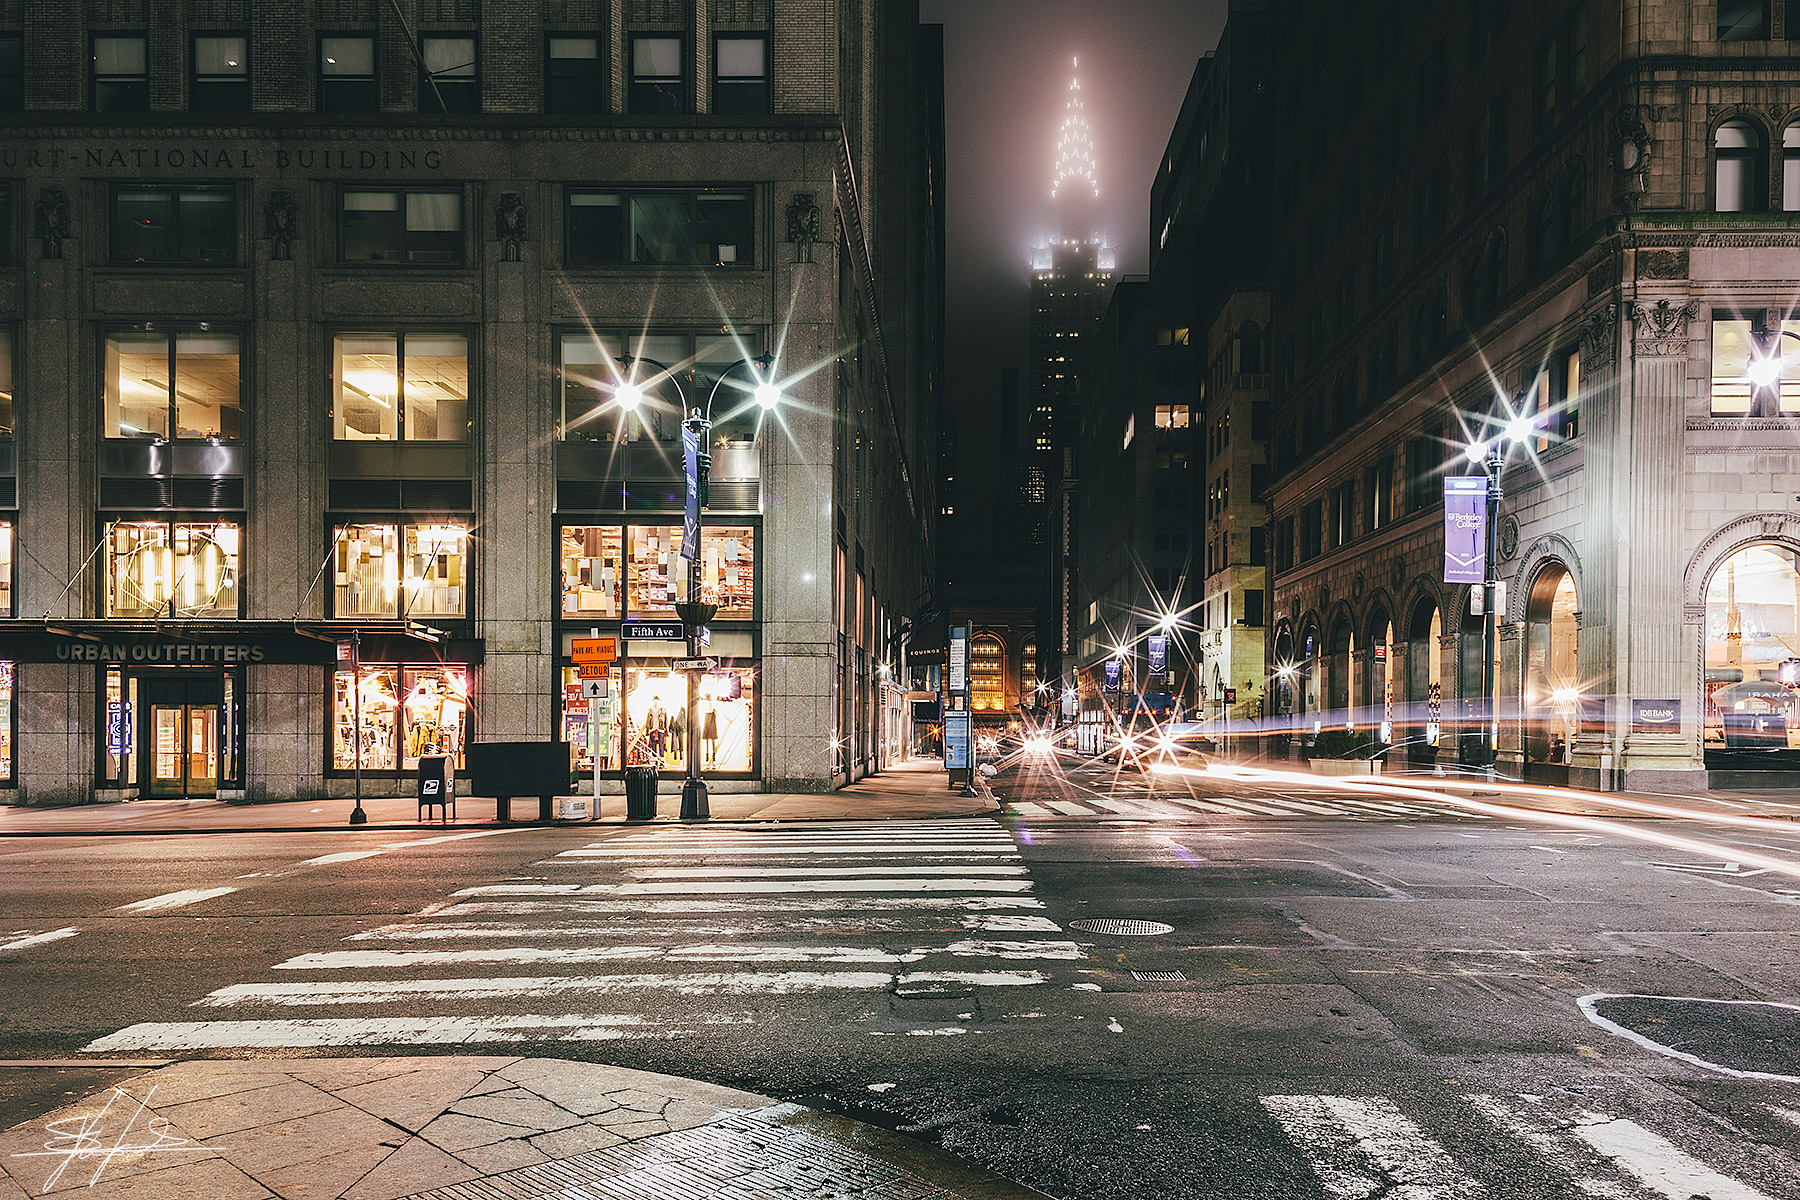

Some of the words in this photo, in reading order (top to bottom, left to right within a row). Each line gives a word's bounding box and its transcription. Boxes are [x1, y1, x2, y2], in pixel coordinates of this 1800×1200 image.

[276, 150, 442, 169] BUILDING
[1455, 513, 1483, 522] Berkeley
[1456, 520, 1482, 529] College
[631, 627, 654, 636] Fifth
[656, 627, 674, 636] Ave
[56, 643, 127, 662] URBAN
[132, 644, 264, 662] OUTFITTERS
[573, 646, 584, 654] PARK
[585, 646, 593, 654] AVE
[910, 648, 940, 656] EQUINOX
[675, 661, 689, 669] ONE
[697, 660, 712, 668] WAY
[581, 666, 608, 675] DETOUR
[1640, 709, 1653, 717] IDB
[1653, 709, 1674, 717] BANK
